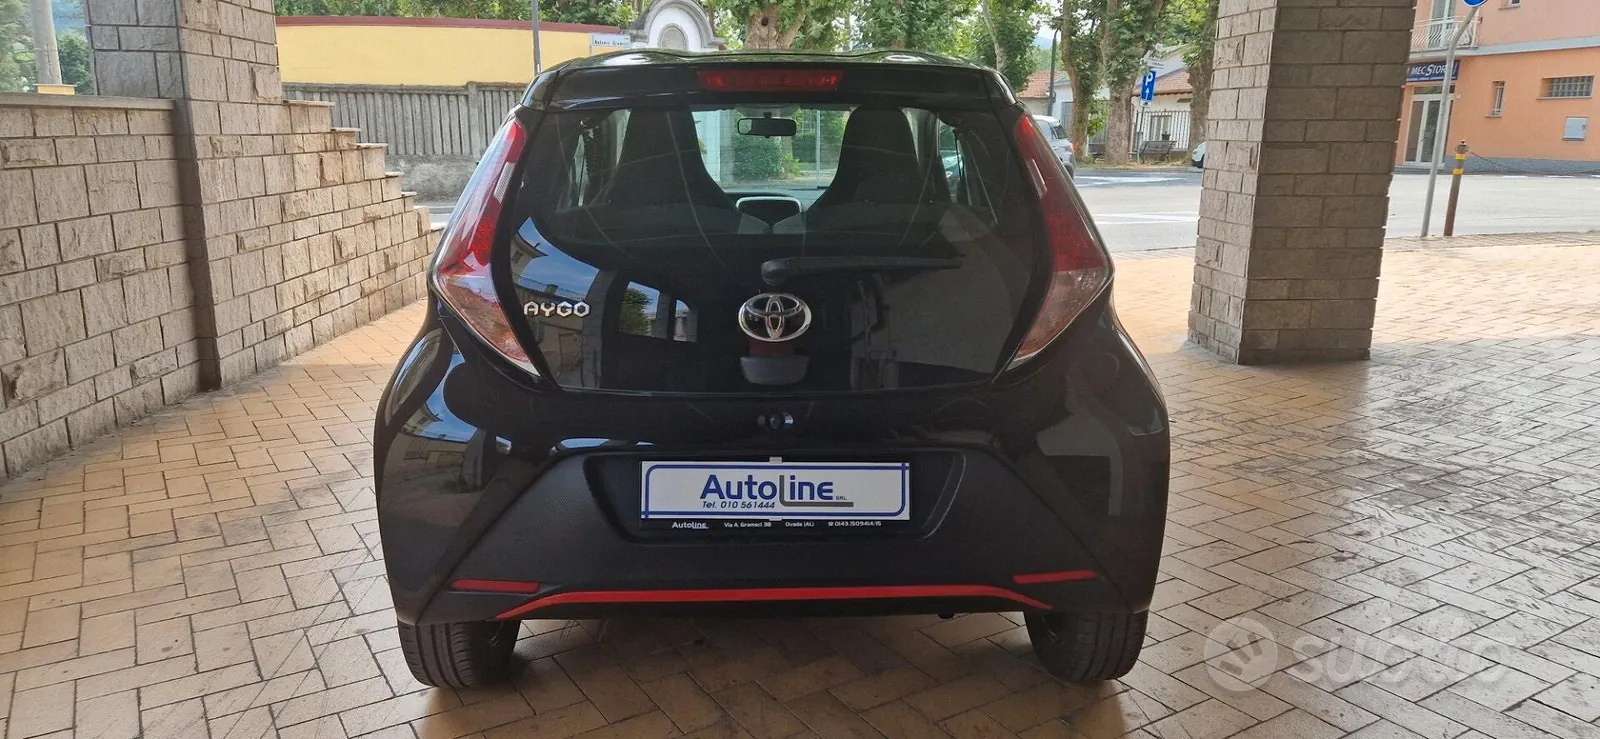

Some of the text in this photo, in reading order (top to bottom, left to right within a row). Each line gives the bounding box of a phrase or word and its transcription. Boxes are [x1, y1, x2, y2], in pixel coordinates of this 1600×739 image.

[1411, 63, 1448, 77] MECSTOR
[1145, 72, 1154, 87] P
[523, 301, 590, 318] AYGO
[702, 501, 775, 509] Tel. 010 561444
